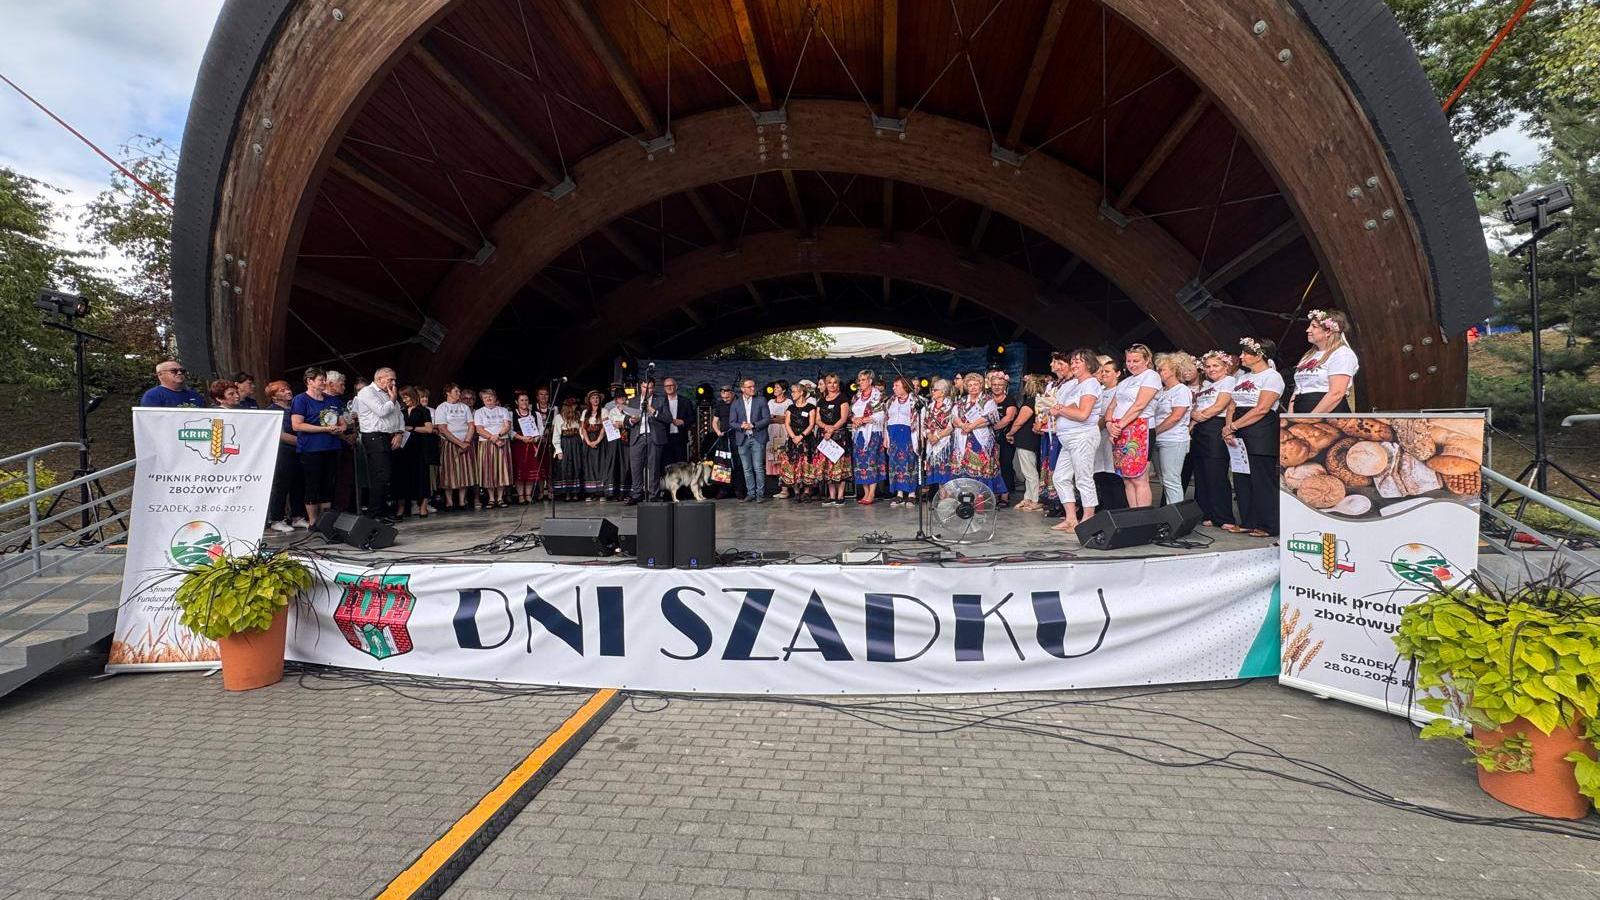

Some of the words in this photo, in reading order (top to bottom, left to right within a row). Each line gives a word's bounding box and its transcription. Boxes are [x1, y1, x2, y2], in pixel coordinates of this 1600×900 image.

[181, 430, 209, 438] KRIR
[194, 473, 262, 482] PRODUKTÓW
[148, 504, 192, 513] SZADEK,
[195, 504, 246, 513] 28.06.2025
[1290, 541, 1319, 551] KRIR
[1352, 598, 1404, 616] produ
[453, 584, 625, 657] DNI
[660, 585, 1111, 662] SZADKU
[1314, 608, 1401, 634] zbożowyc
[1323, 661, 1399, 685] 28.06.2025
